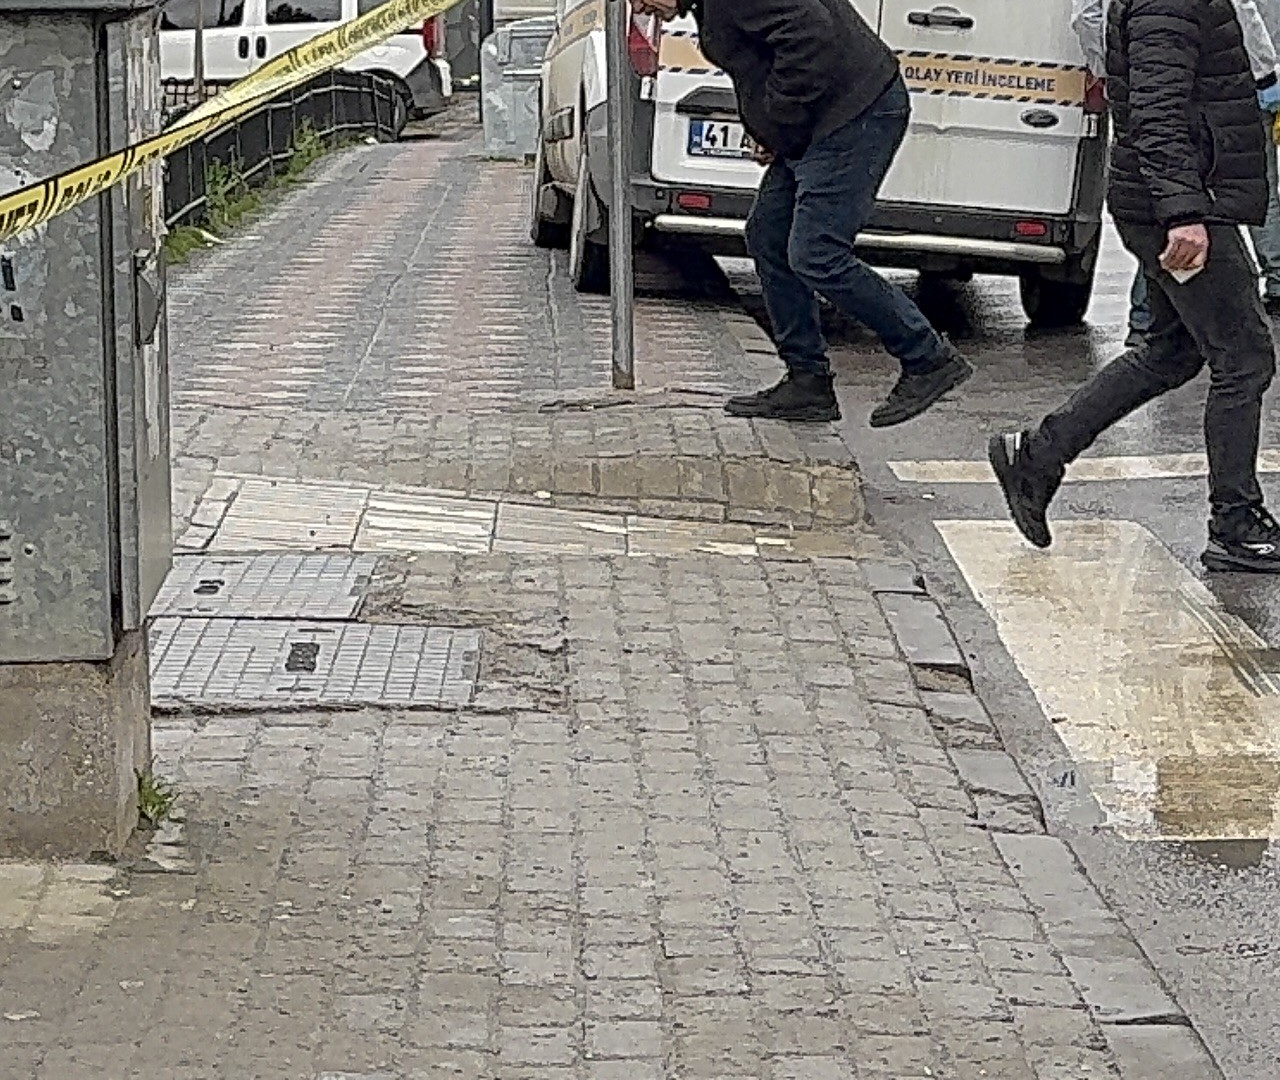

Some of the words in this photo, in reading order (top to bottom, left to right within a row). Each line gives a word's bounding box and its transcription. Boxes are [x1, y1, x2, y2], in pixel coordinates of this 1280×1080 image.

[905, 66, 942, 81] OLAY
[946, 68, 978, 86] YERİ
[982, 70, 1056, 92] İNCELEME
[705, 123, 729, 147] 41
